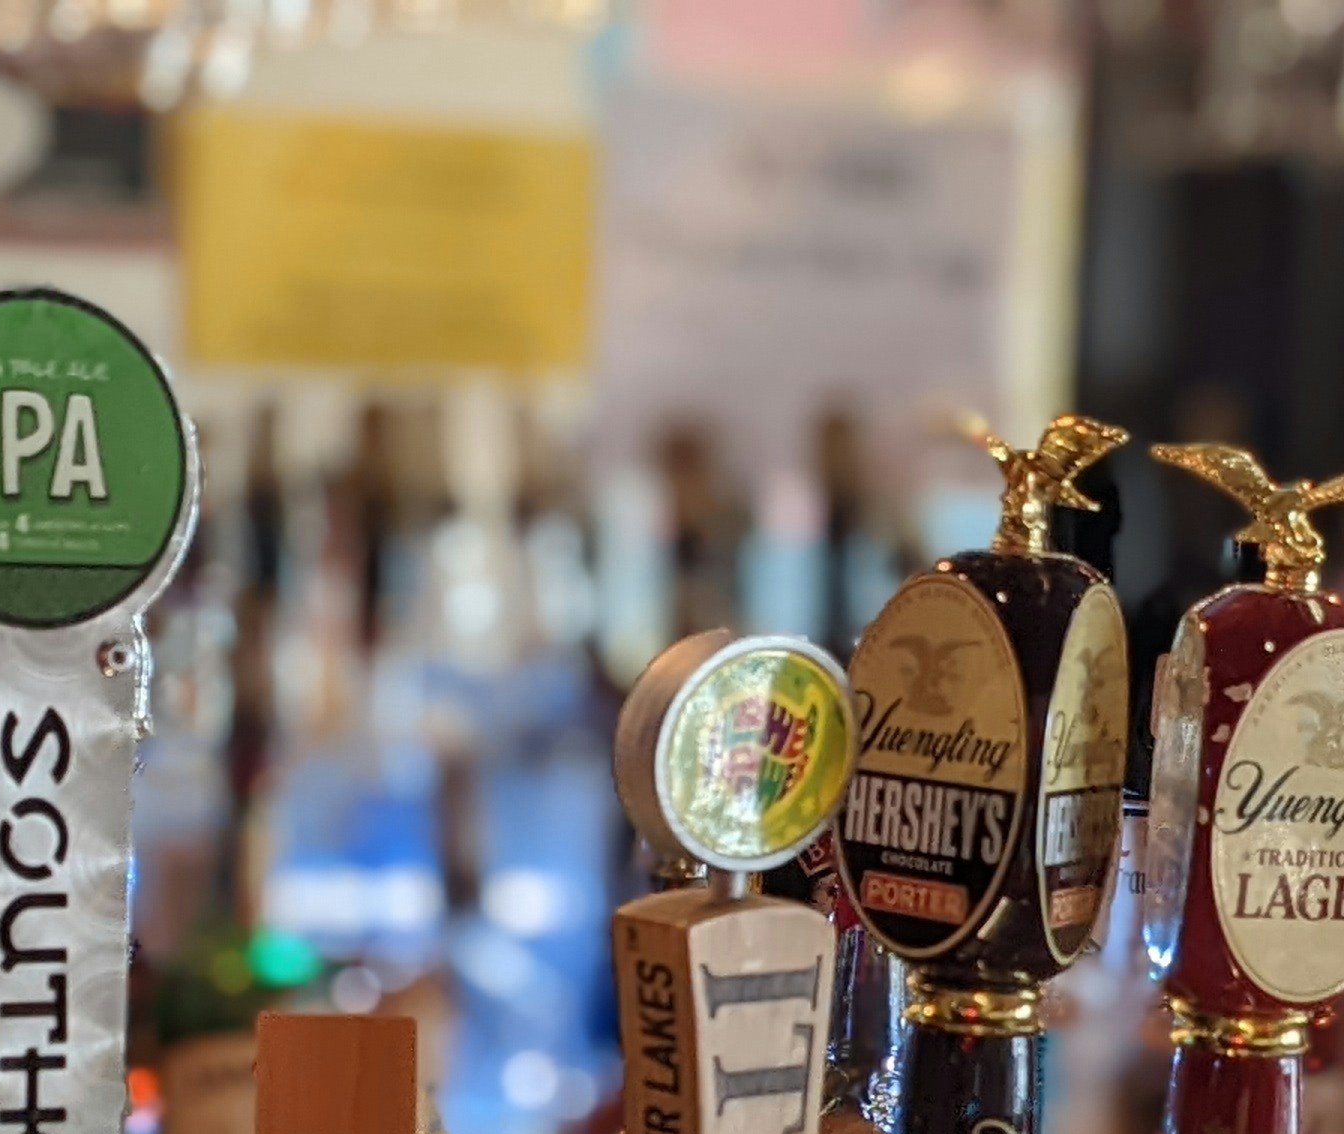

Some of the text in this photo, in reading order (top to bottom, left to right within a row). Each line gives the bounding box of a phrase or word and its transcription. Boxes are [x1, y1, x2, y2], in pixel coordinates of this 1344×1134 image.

[853, 690, 1012, 783] Yuengling
[844, 774, 1008, 867] HERSHEY'S
[881, 849, 954, 876] CHOCOLATE
[636, 959, 680, 1096] LAKES
